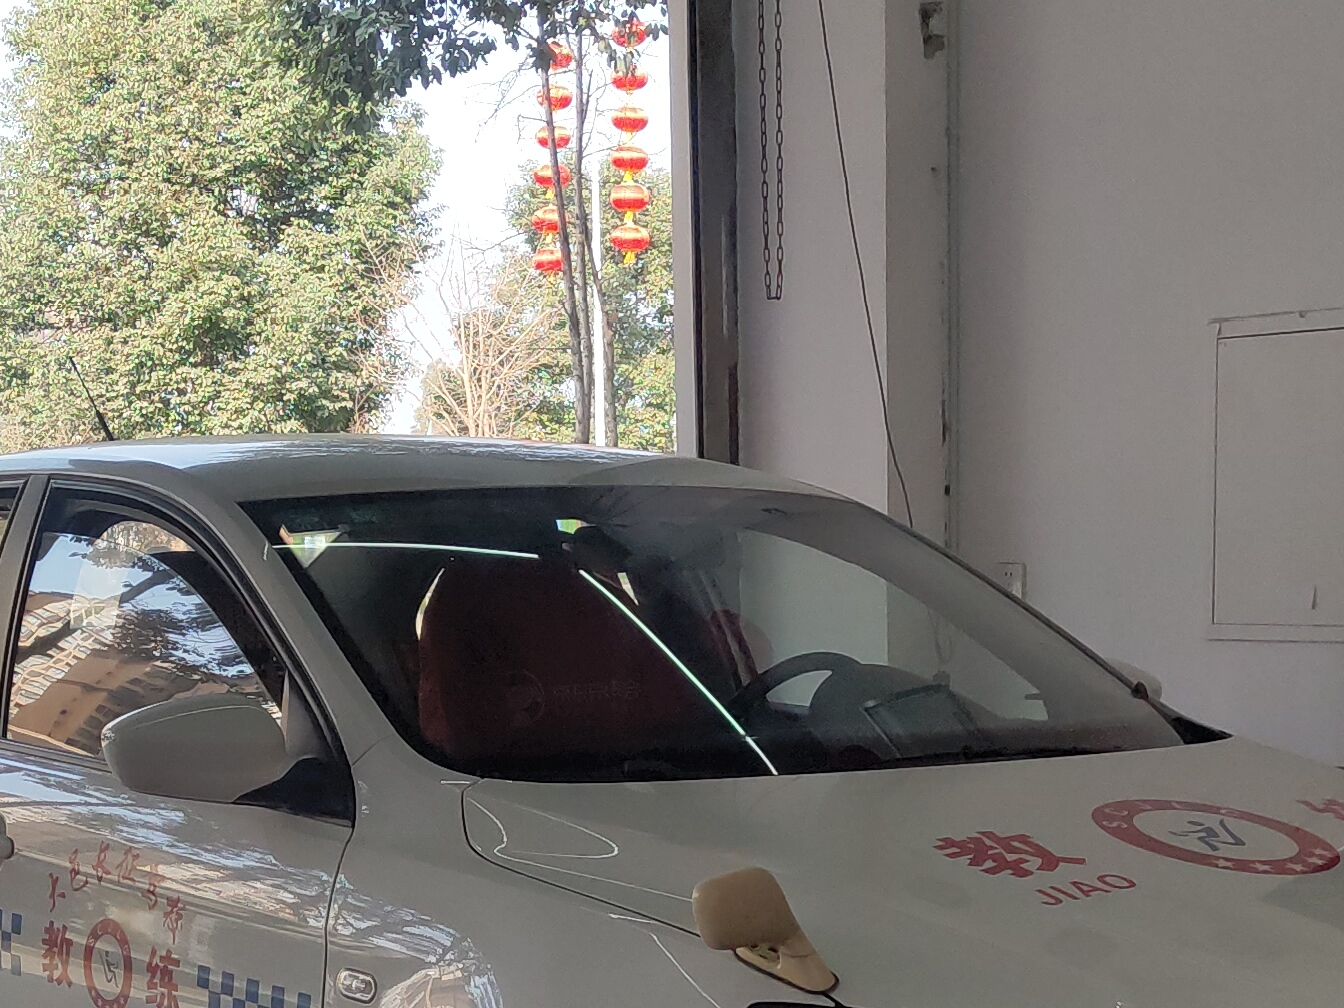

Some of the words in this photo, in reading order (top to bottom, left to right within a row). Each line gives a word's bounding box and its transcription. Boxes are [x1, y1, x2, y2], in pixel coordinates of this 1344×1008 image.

[933, 830, 1087, 878] 教
[1033, 873, 1138, 907] JIAO
[41, 919, 74, 989] 教
